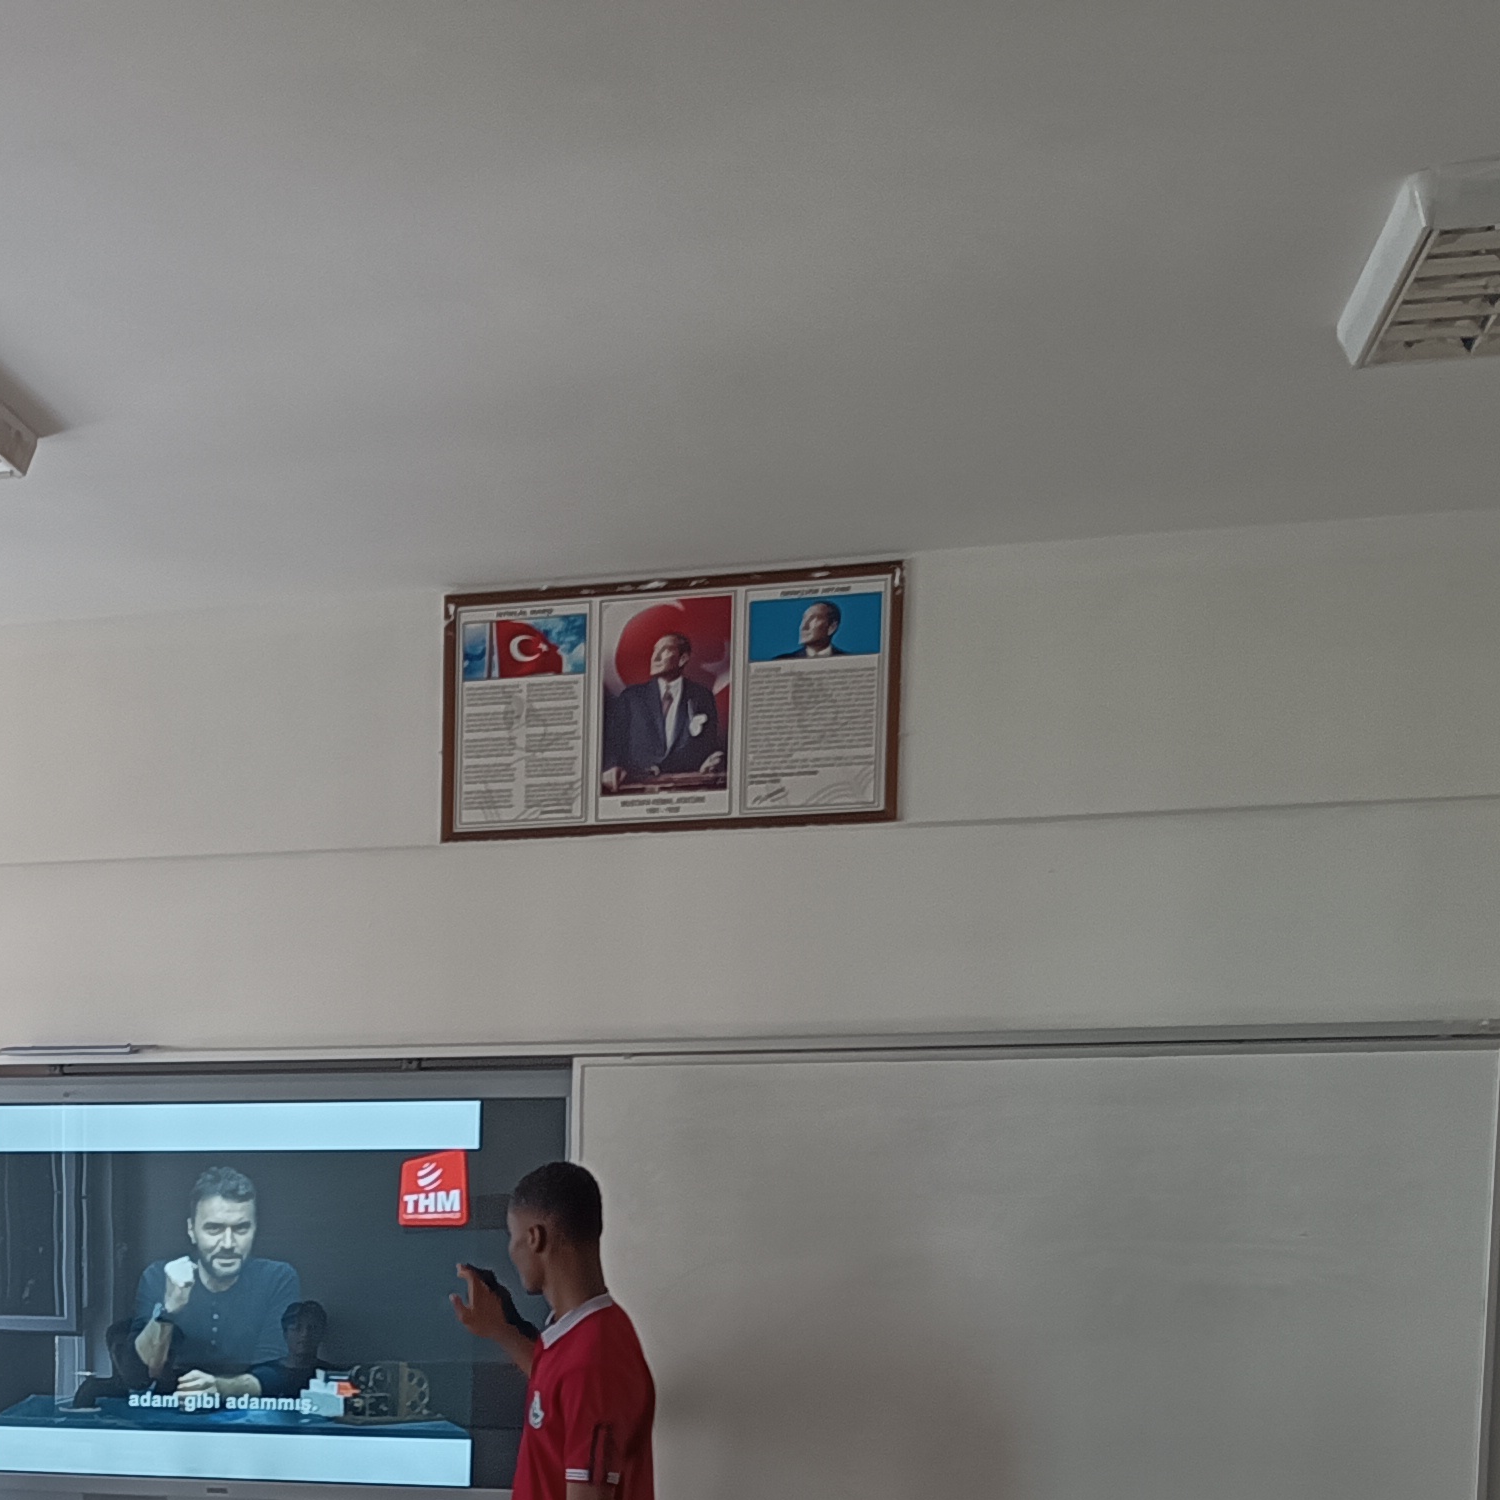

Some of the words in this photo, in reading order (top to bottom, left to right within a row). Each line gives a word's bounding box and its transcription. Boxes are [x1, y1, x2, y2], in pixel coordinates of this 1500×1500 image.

[402, 1189, 461, 1213] THM
[128, 1391, 179, 1408] adam
[184, 1392, 220, 1412] gibi
